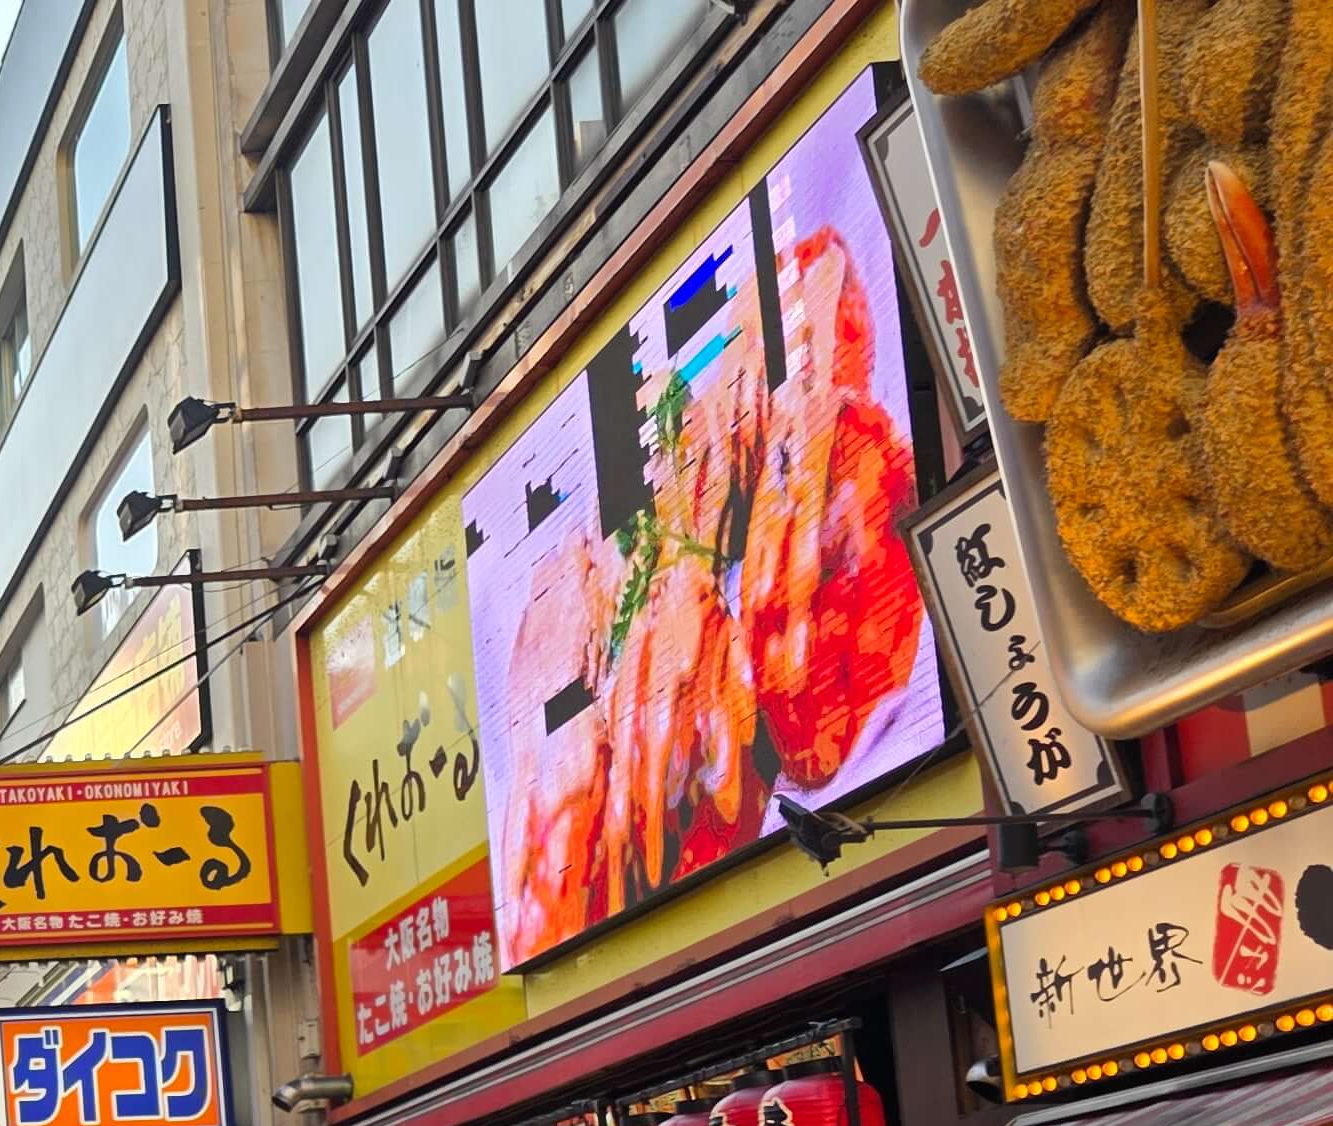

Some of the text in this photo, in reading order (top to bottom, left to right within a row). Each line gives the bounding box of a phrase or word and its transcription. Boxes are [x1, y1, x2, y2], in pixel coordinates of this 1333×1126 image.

[954, 523, 1073, 787] 紅しょうが
[1, 908, 204, 932] 大阪名物 たこ焼・お好み焼
[383, 898, 450, 971] 大阪名物
[357, 932, 494, 1046] たこ焼・お好み焼
[1030, 922, 1203, 1029] 新世界
[12, 1025, 211, 1125] ダイコク
